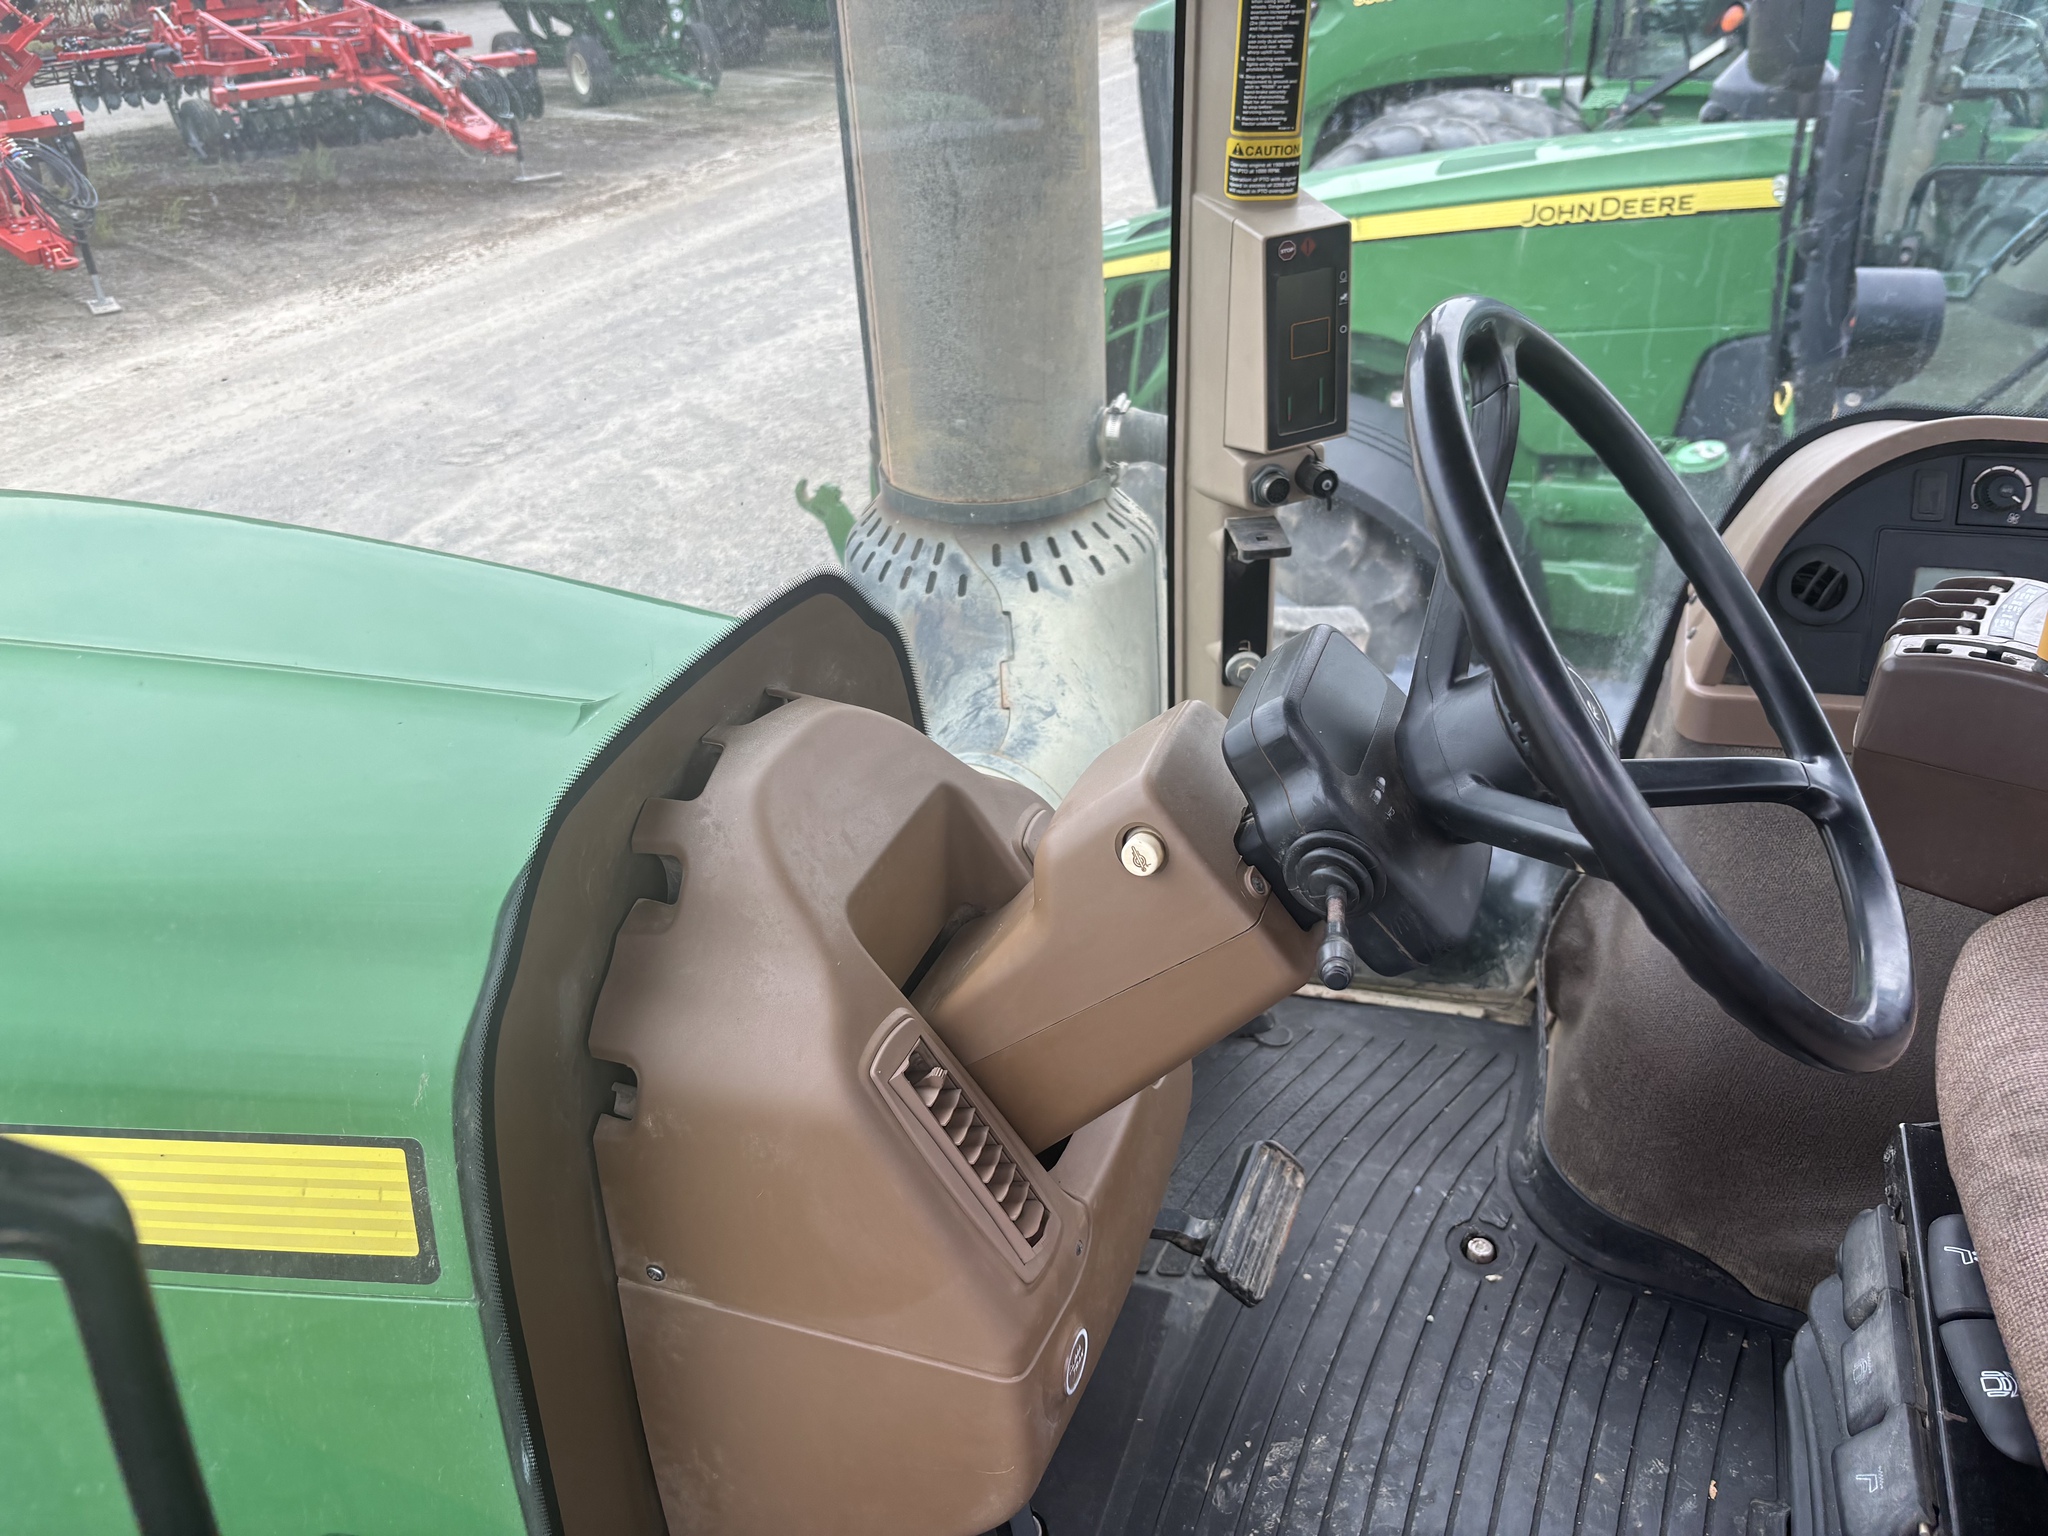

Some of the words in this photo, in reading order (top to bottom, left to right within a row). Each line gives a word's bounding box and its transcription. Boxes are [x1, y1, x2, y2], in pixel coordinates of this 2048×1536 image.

[1245, 144, 1300, 156] CAUTION
[1522, 201, 1595, 224] JOHN
[1601, 194, 1694, 217] DEERE
